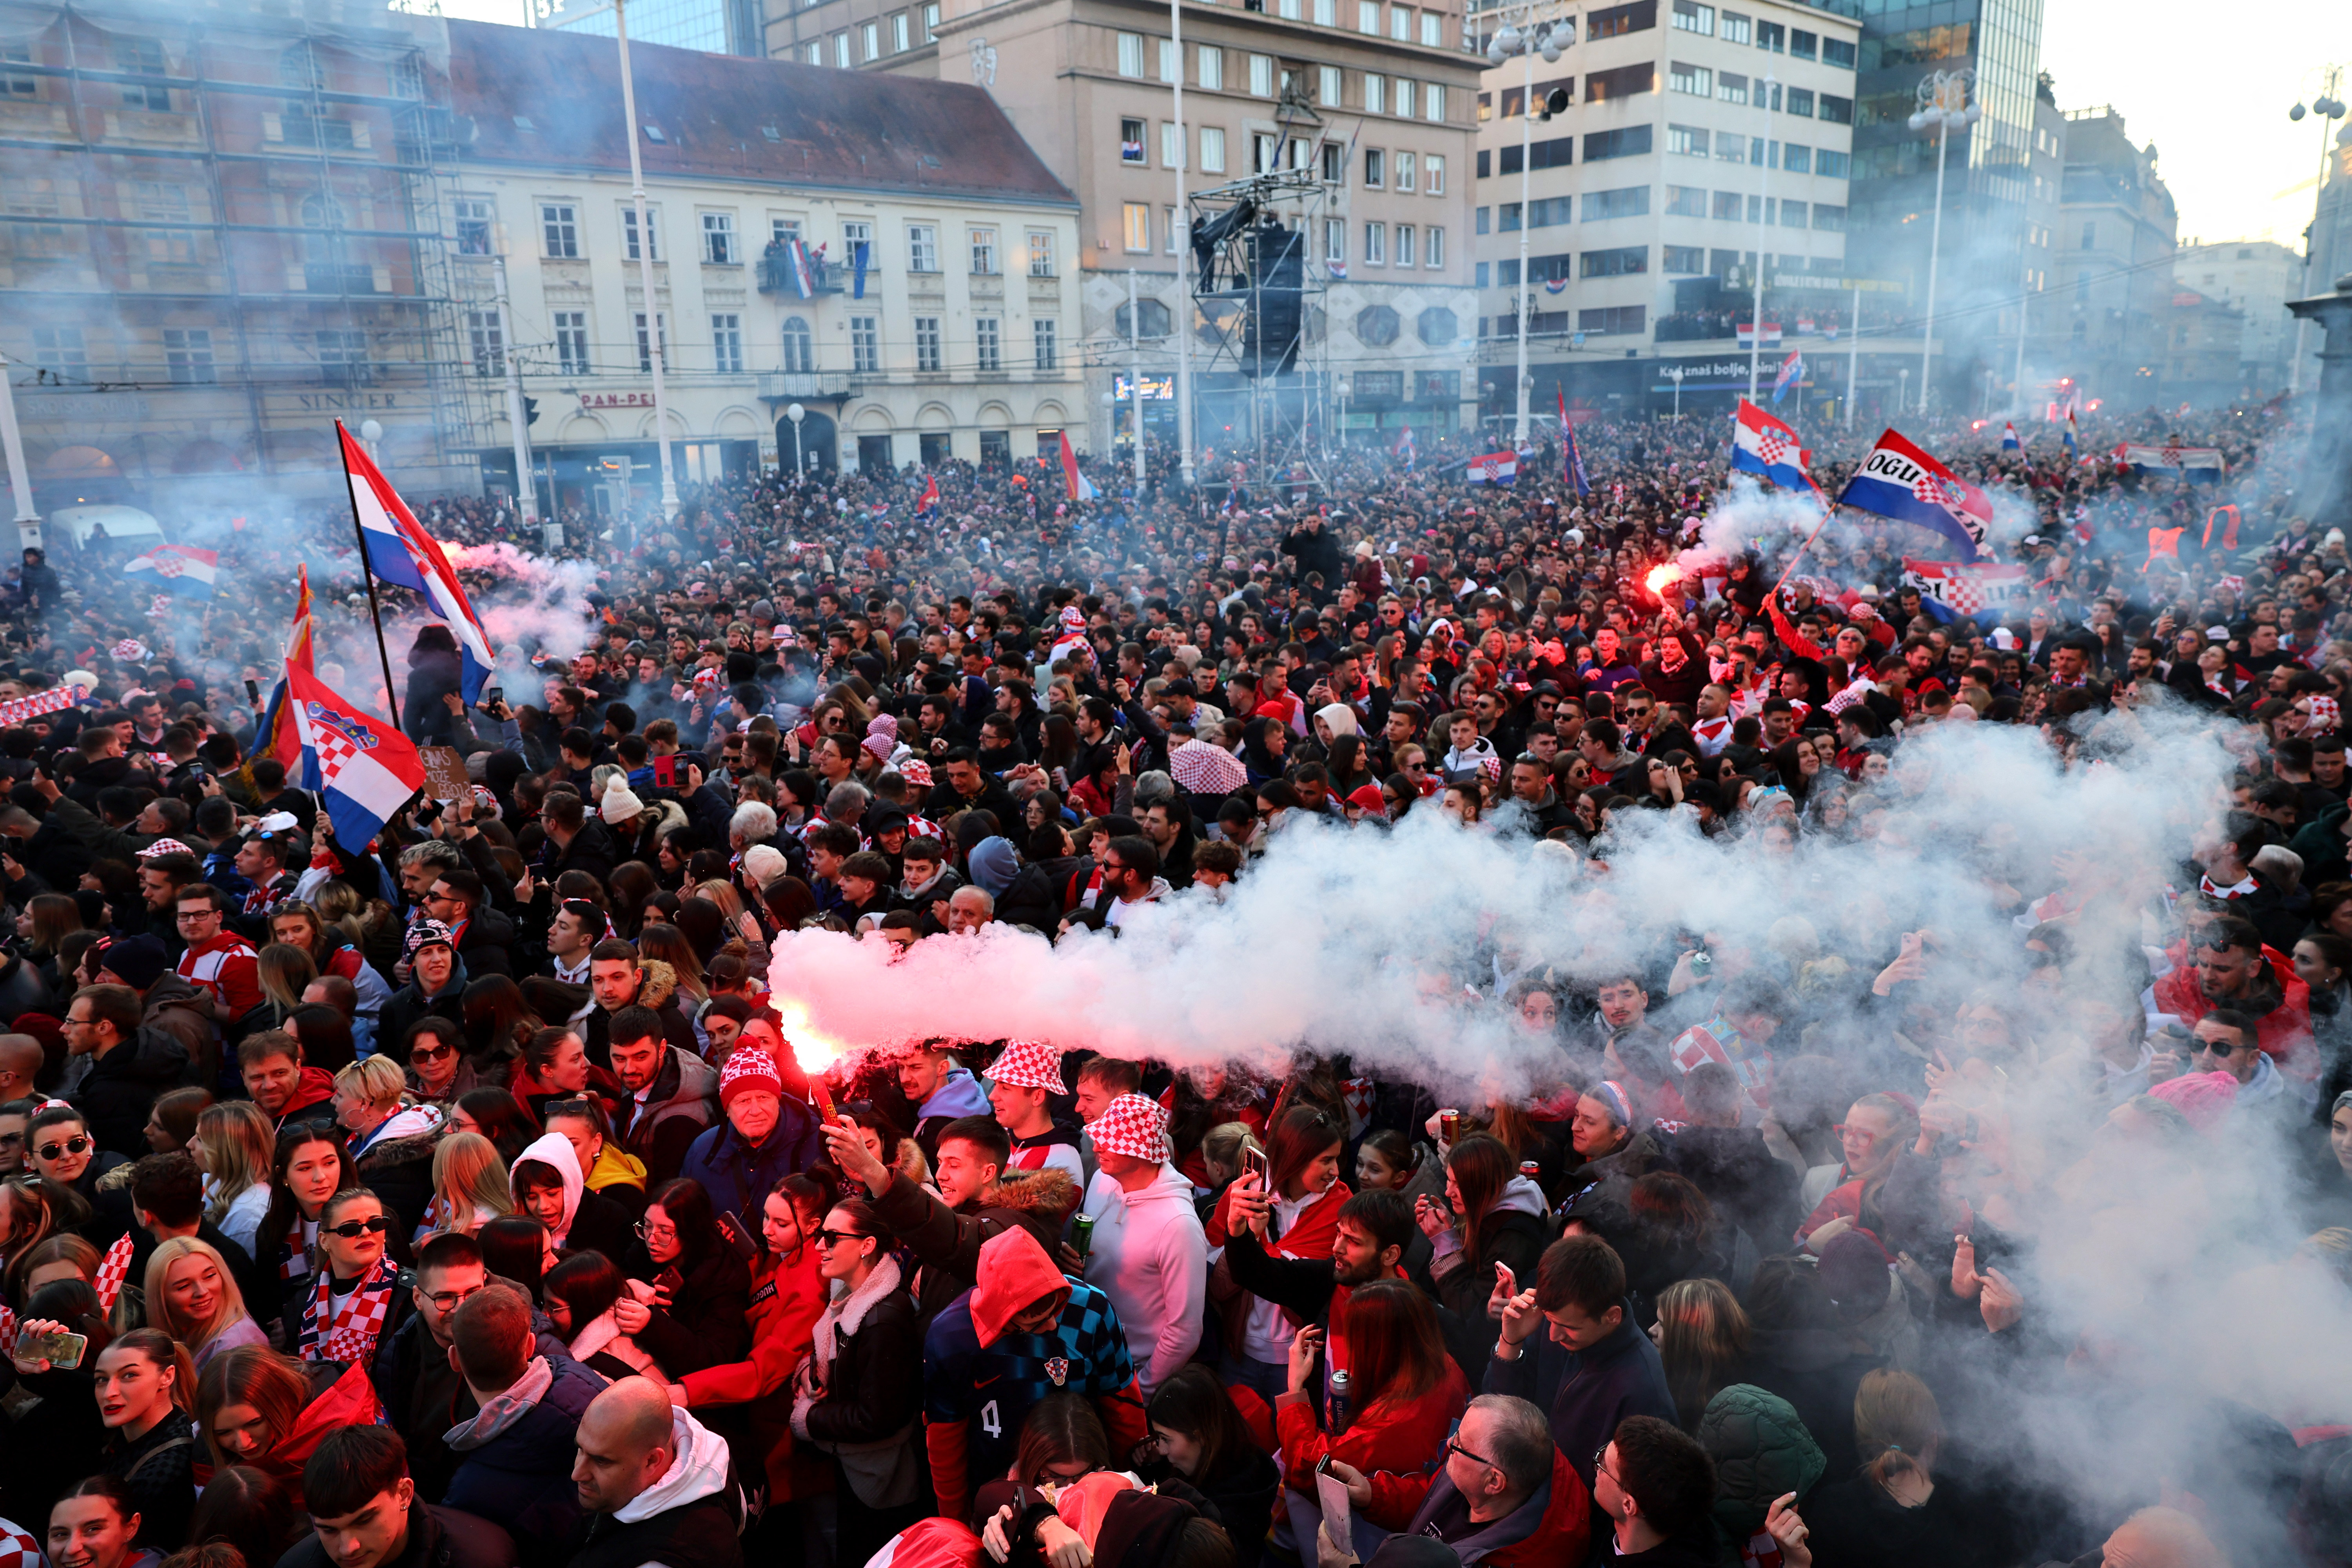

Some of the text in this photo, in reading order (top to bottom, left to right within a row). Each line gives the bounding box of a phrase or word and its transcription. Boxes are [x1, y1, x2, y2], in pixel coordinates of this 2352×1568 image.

[1684, 363, 1711, 376] znaš
[1713, 362, 1750, 378] bolje,
[582, 394, 655, 406] PAN-PE
[1867, 454, 1920, 482] OGU
[0, 691, 64, 724] ROATIA
[826, 1103, 838, 1125] RED
[756, 1284, 774, 1301] HUGO
[981, 1400, 1002, 1439] 4
